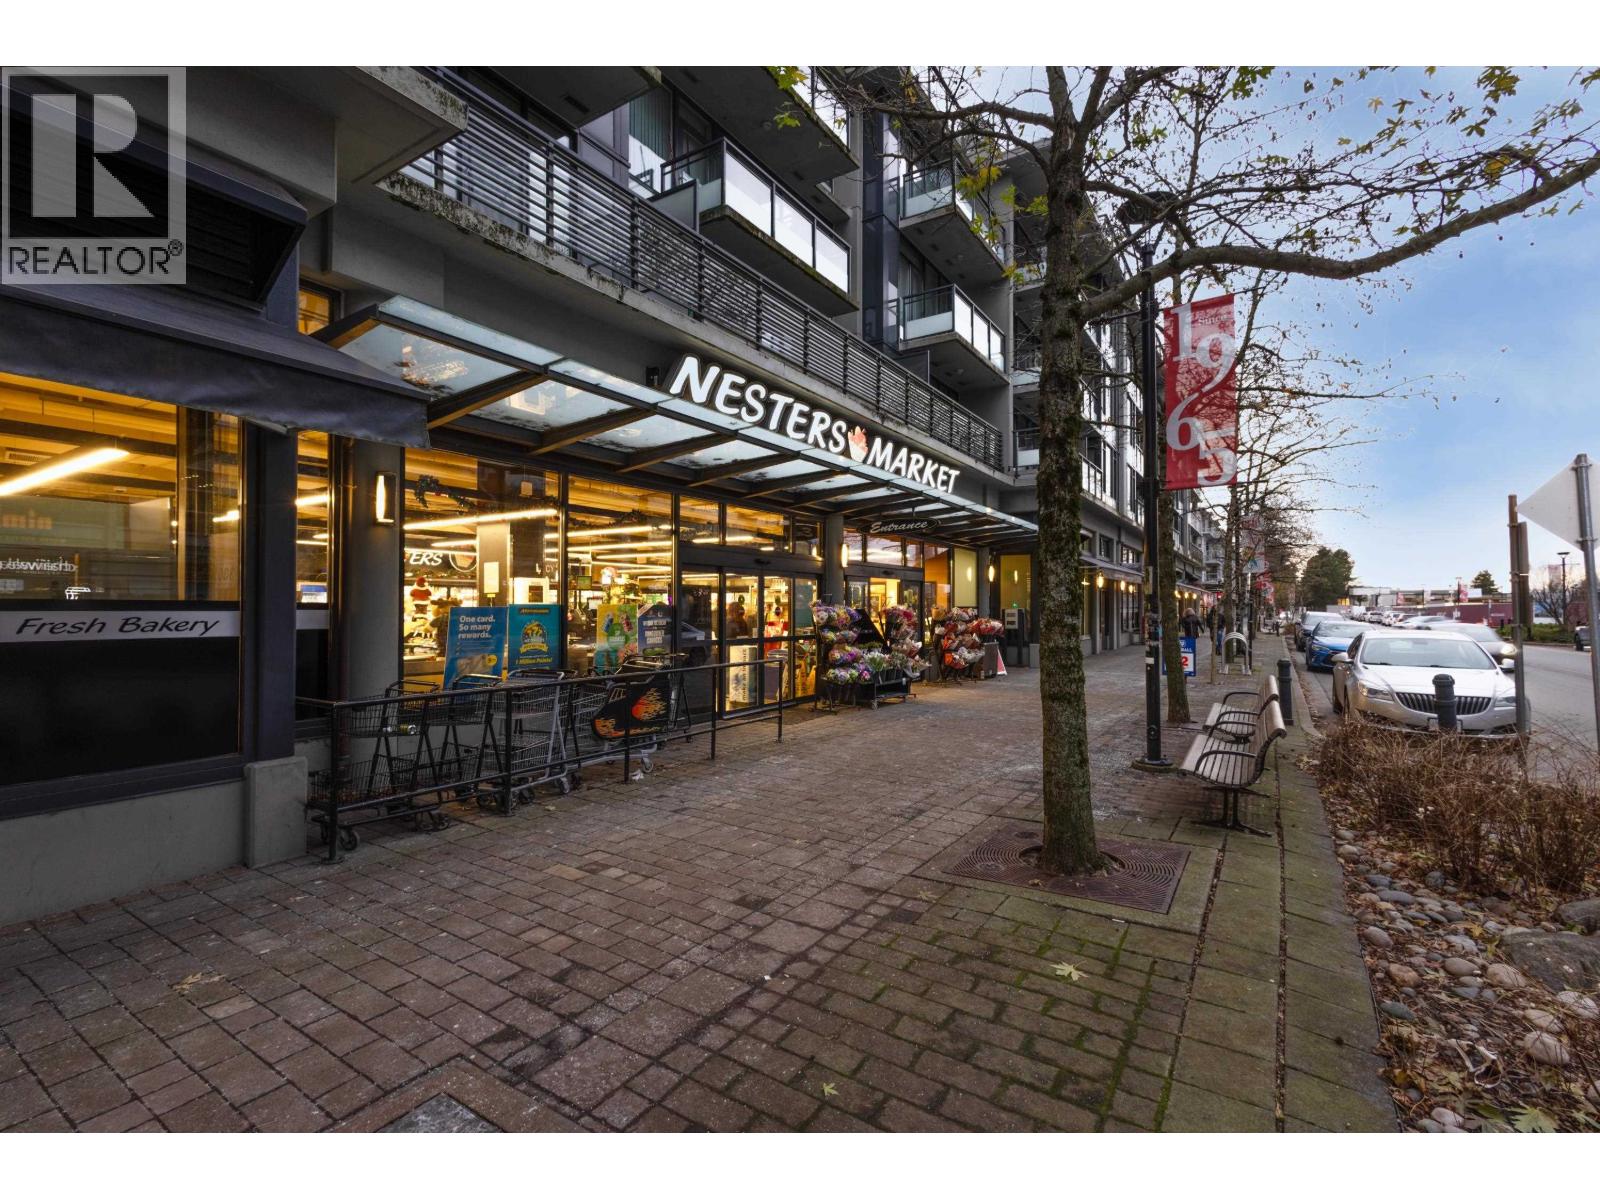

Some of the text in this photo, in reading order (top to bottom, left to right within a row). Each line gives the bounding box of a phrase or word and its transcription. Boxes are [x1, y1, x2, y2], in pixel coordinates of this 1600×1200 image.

[670, 356, 960, 493] NESTERS MARKET
[870, 521, 928, 533] Entrance
[409, 551, 443, 566] ERS
[459, 615, 496, 623] One card.
[16, 617, 220, 636] Fresh Bakery
[470, 624, 492, 632] many
[458, 631, 491, 639] rewards.
